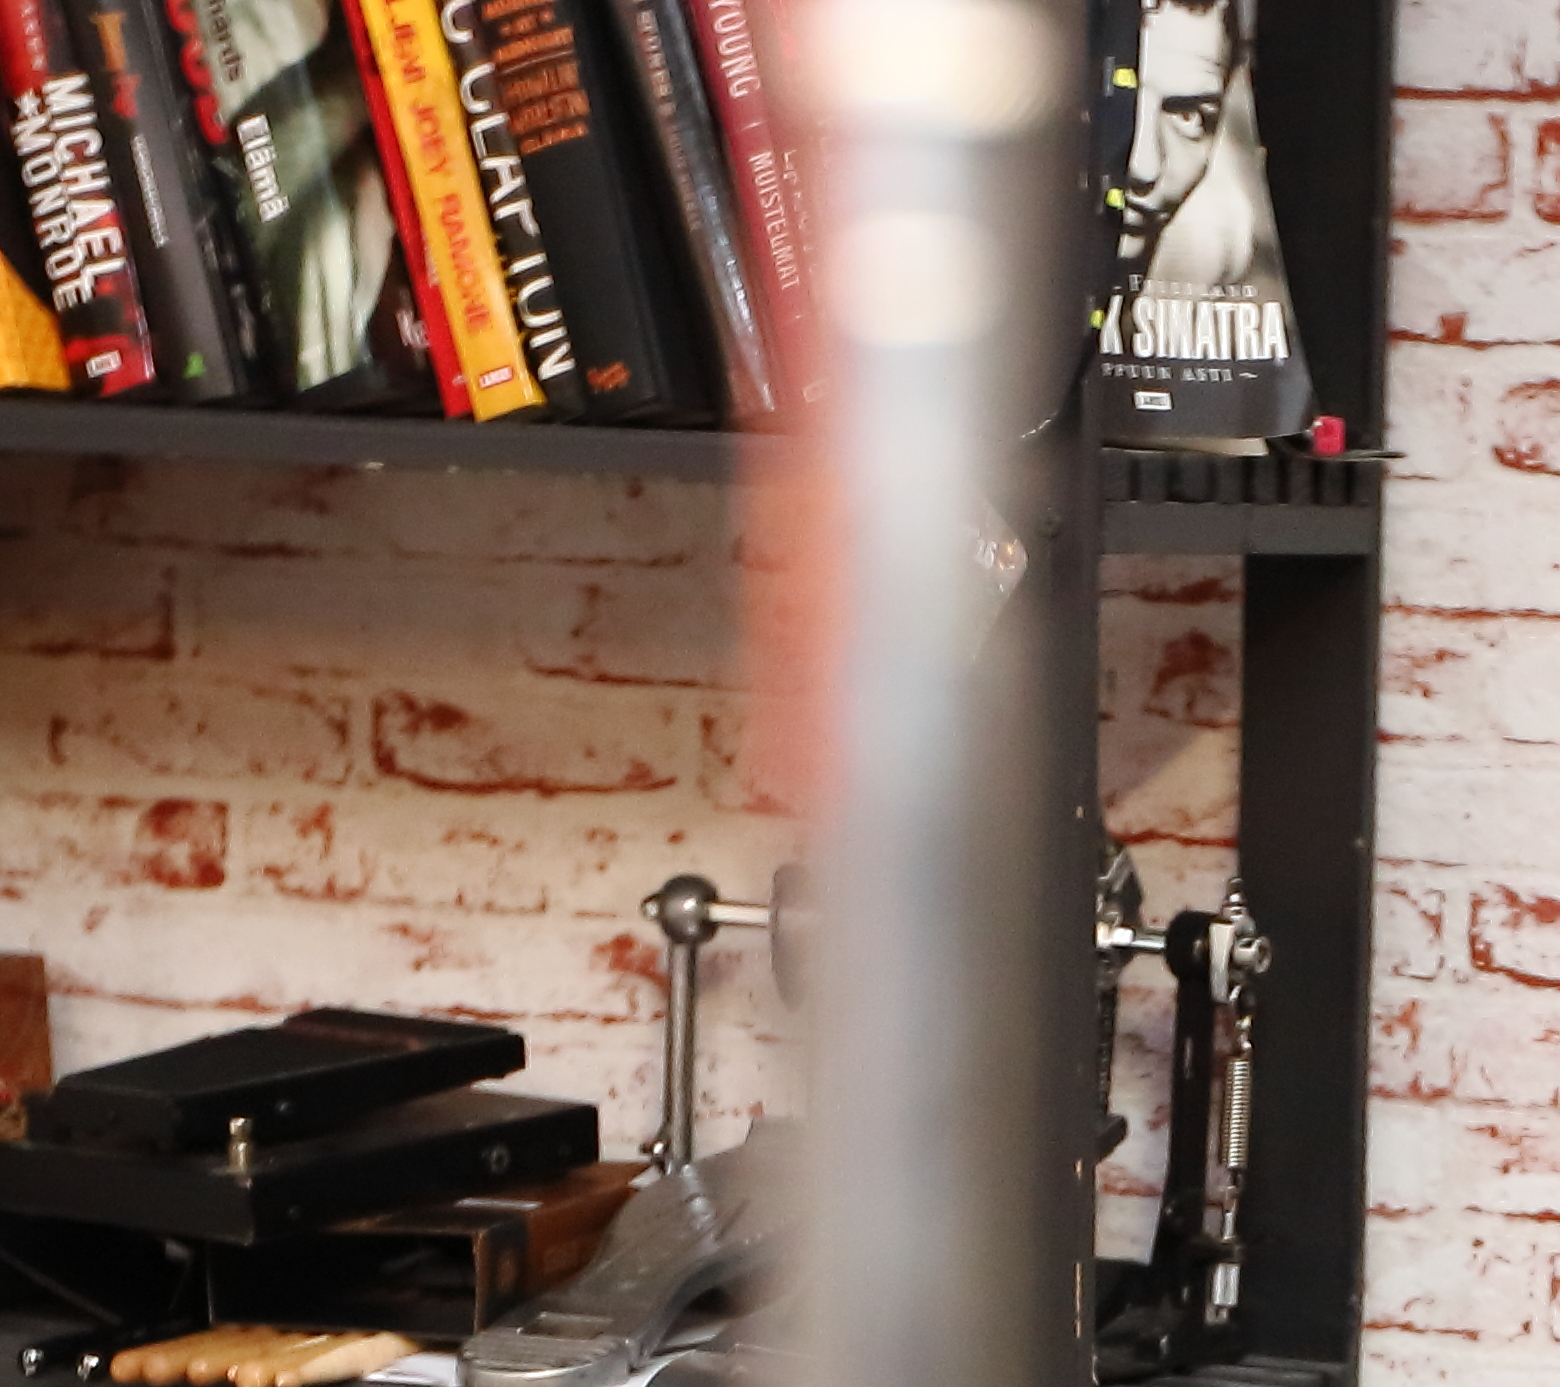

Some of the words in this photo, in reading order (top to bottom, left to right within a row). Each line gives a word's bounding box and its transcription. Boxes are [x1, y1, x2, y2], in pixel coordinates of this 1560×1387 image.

[11, 113, 95, 313] MONROE
[40, 72, 126, 288] MICHAEL
[237, 114, 290, 222] Elämä
[439, 192, 491, 333] RAMONE
[1132, 295, 1289, 361] SINATRA
